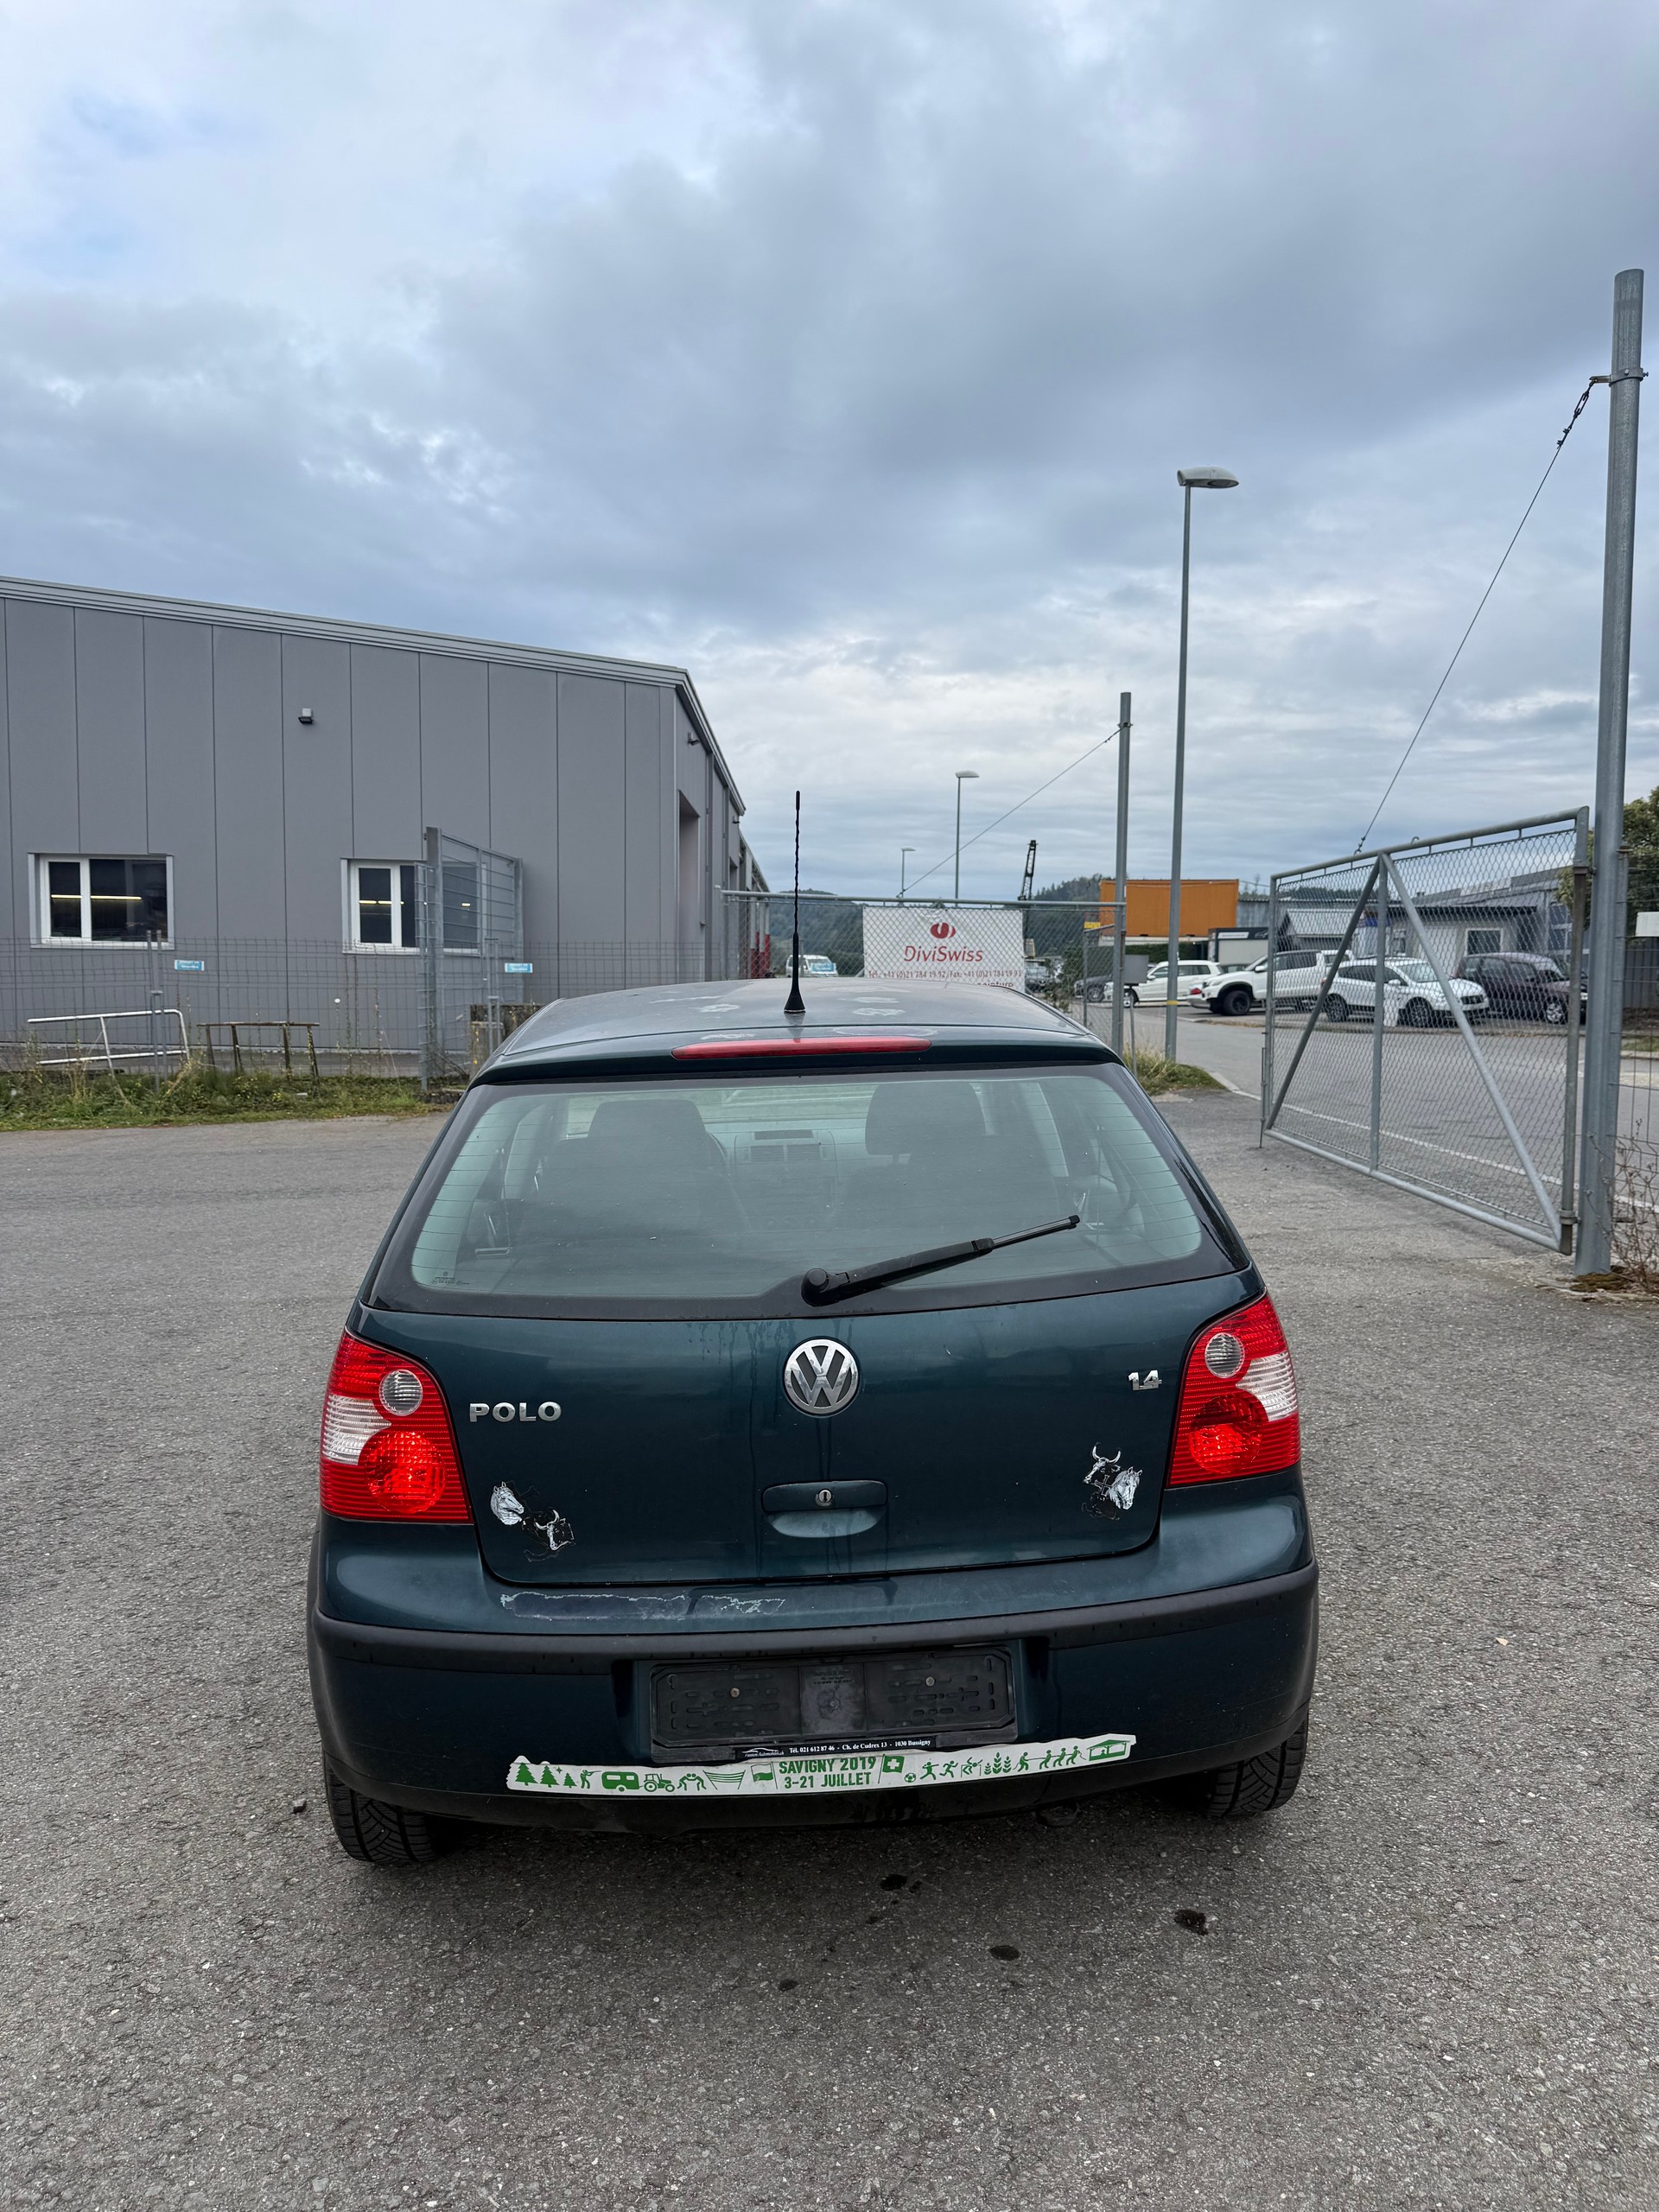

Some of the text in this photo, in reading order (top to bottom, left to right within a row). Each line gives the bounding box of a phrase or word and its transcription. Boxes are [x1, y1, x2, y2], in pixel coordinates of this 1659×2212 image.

[904, 945, 983, 963] DiviSwiss
[469, 1401, 562, 1422] POLO
[779, 1756, 877, 1774] SAVIGNY 2019
[785, 1771, 872, 1789] 3-21 JUILLET
